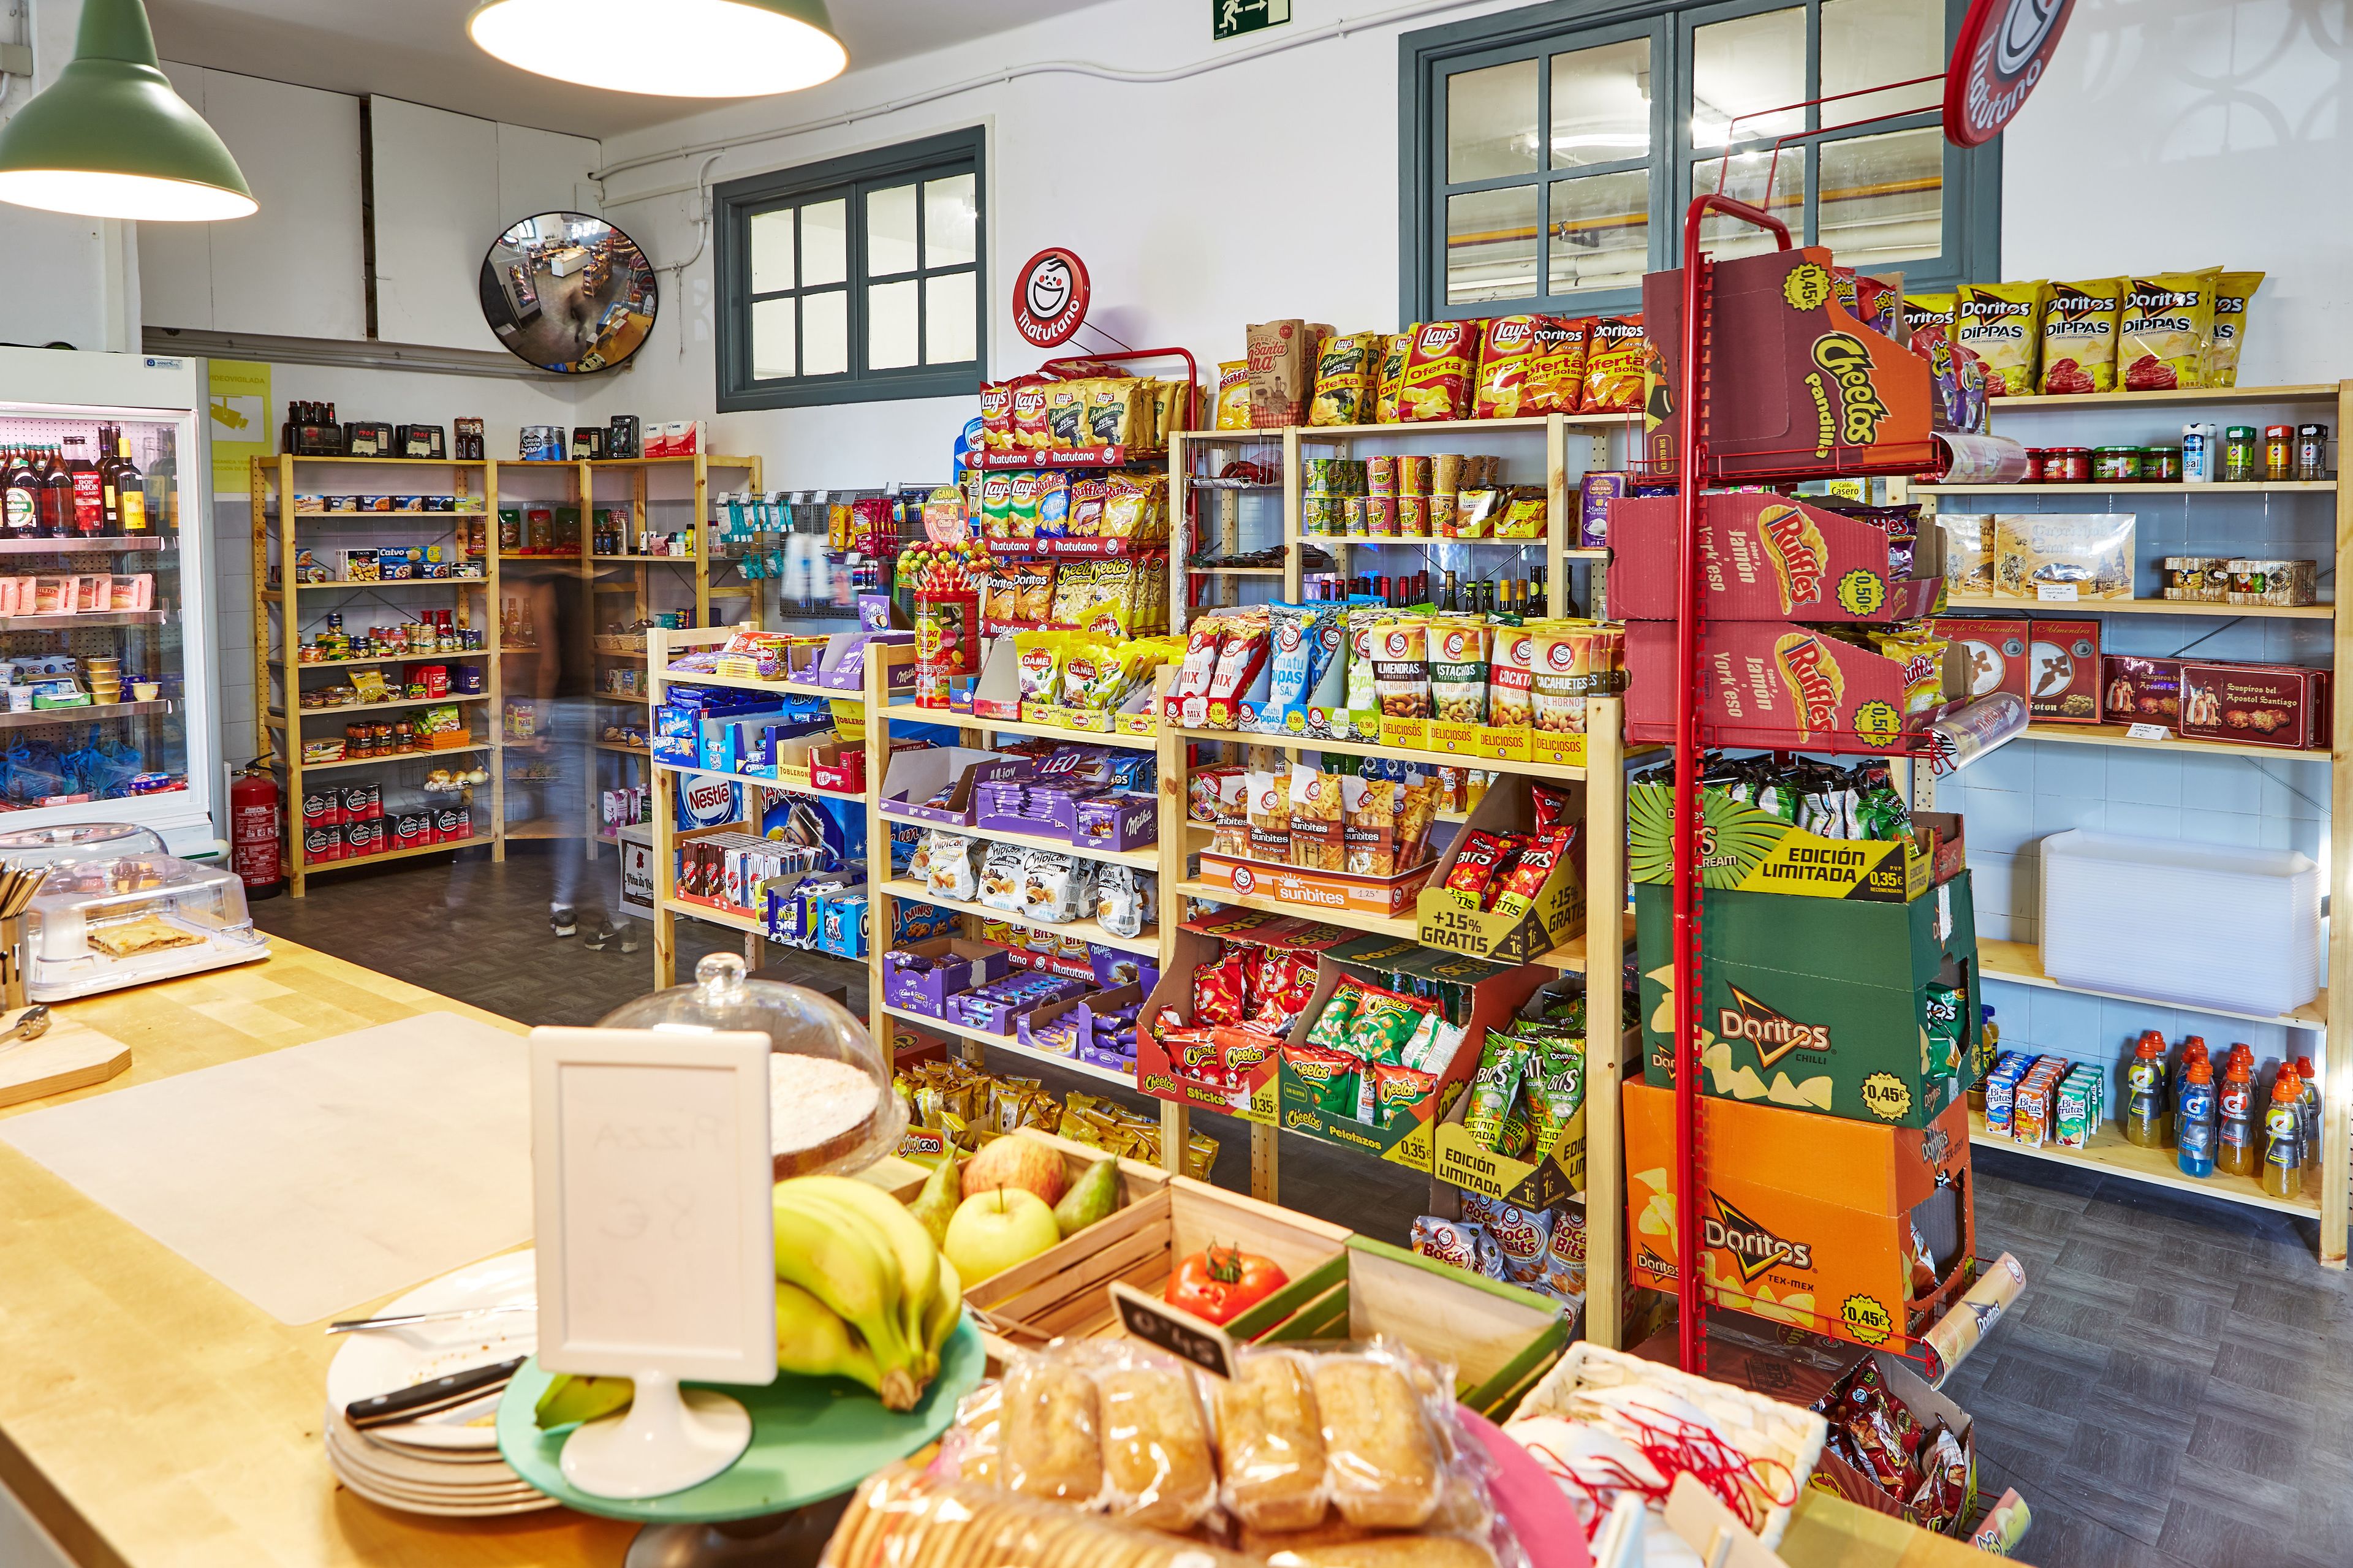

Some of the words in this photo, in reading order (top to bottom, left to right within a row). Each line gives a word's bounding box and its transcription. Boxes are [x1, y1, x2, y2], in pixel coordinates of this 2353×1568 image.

[1799, 269, 1817, 311] 0,45€
[2047, 298, 2115, 316] Doritos
[2124, 292, 2198, 309] Doritos
[1961, 301, 2031, 318] Doritos
[1422, 327, 1458, 349] Lay's
[1495, 322, 1531, 344] Lay's
[1534, 330, 1582, 344] Doritos
[1594, 325, 1643, 338] Doritos
[1254, 341, 1285, 355] Santa
[1335, 338, 1353, 351] Lay's
[1248, 349, 1272, 372] Ana
[1526, 356, 1583, 376] Oferta
[1585, 355, 1644, 375] Oferta
[1410, 361, 1461, 380] Oferta
[1553, 368, 1583, 376] Bolsa
[1316, 377, 1358, 393] Oferta
[1813, 331, 1892, 446] Cheetos
[982, 392, 1007, 412] Lay's
[1015, 393, 1045, 413] Lay's
[1056, 393, 1072, 404] Lay's
[1096, 393, 1114, 404] Lay's
[1805, 373, 1836, 458] Pandilla
[1036, 472, 1067, 495] Ruffles
[1072, 482, 1105, 501] Ruffles
[1831, 487, 1859, 495] Casero
[938, 490, 955, 499] GANA
[1728, 529, 1757, 583] Jamón
[1749, 541, 1760, 560] Sabor
[1767, 508, 1825, 604] Ruffles
[1014, 574, 1047, 585] Doritos
[1090, 558, 1132, 586] Cheetos
[1855, 575, 1872, 611] 0,50€
[1091, 621, 1115, 633] DAMEL
[1969, 624, 2021, 634] Almendra
[2038, 625, 2090, 634] Almendra
[1024, 657, 1050, 666] DAMEL
[1070, 665, 1095, 676] DAMEL
[1767, 668, 1776, 688] Sabor
[2140, 672, 2169, 681] Suspiros
[1537, 675, 1588, 689] CACAHUETES
[1714, 652, 1743, 718] York'eso
[1745, 656, 1775, 711] Jamón
[1784, 638, 1840, 733] Ruffles
[2140, 681, 2166, 691] Apostol
[2227, 683, 2264, 694] Suspiros
[2265, 686, 2276, 694] del
[1544, 697, 1550, 706] AL
[1553, 698, 1580, 707] HORNO
[2227, 694, 2257, 704] Apostol
[2260, 695, 2297, 708] Santiago
[1187, 710, 1202, 719] MIX
[1384, 723, 1422, 736] DELICIOSOS
[1431, 727, 1471, 741] DELICIOSOS
[1481, 734, 1523, 748] DELICIOSOS
[1537, 738, 1581, 752] DELICIOSOS
[746, 763, 765, 772] OREO
[1040, 754, 1081, 775] LEO
[689, 784, 729, 810] Nestlé
[1127, 809, 1153, 836] Milka
[1290, 821, 1328, 833] sunbites
[1344, 831, 1379, 841] sunbites
[1457, 851, 1496, 865] BITS
[1520, 851, 1553, 868] BITS
[1789, 847, 1865, 866] EDICIÓN
[1047, 864, 1061, 873] MINI
[1763, 863, 1857, 883] LIMITADA
[1870, 871, 1903, 886] 0,35€
[1280, 888, 1344, 905] sunbites
[904, 904, 934, 925] MINIS
[1434, 911, 1481, 933] +15%
[1033, 929, 1055, 939] Bits
[1422, 926, 1488, 953] GRATIS
[1510, 941, 1522, 954] 1€
[1366, 995, 1412, 1015] Cheetos
[1719, 1008, 1831, 1051] Doritos
[1226, 1047, 1264, 1069] Cheetos
[1795, 1054, 1827, 1065] CHILLI
[1476, 1061, 1512, 1085] BITS
[1547, 1069, 1578, 1093] BITS
[1145, 1075, 1176, 1093] Cheetos
[1381, 1079, 1418, 1104] Cheetos
[1186, 1086, 1227, 1106] Sticks
[1867, 1086, 1906, 1102] 0,45€
[1251, 1097, 1278, 1113] 0,35€
[1869, 1101, 1906, 1117] RECOMENDADO
[2058, 1106, 2083, 1115] frutas
[1248, 1112, 1276, 1122] RECOMENDADO
[1286, 1109, 1322, 1129] Cheetos
[1329, 1126, 1382, 1150] Pelotazos
[1401, 1140, 1431, 1159] 0,35€
[1446, 1148, 1495, 1177] EDICIÓN
[1439, 1164, 1502, 1198] LIMITADA
[1493, 1227, 1534, 1244] Boca
[1705, 1219, 1812, 1269] Doritos
[1423, 1242, 1464, 1262] Boca
[1505, 1238, 1536, 1255] Bits
[1767, 1274, 1815, 1292] TEX-MEX
[1847, 1310, 1885, 1327] 0,45€
[1977, 1303, 2000, 1335] Doritos
